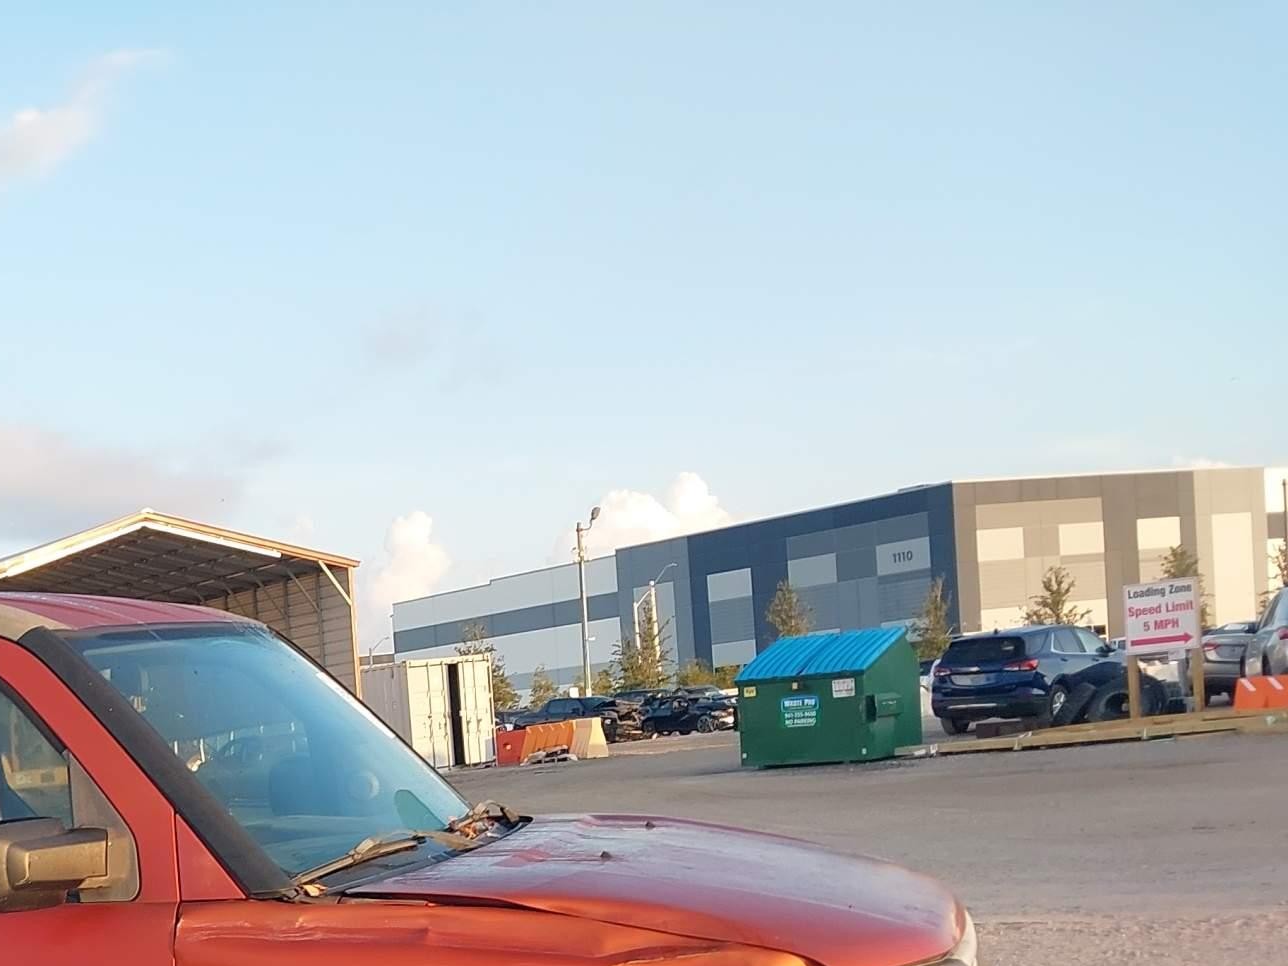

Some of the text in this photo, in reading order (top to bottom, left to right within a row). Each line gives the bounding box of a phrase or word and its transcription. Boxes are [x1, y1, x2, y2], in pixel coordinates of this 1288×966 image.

[892, 550, 914, 563] 1110
[1127, 584, 1192, 600] Loading Zone
[1127, 600, 1194, 619] Speed Limit
[1143, 617, 1180, 632] 5 MPH
